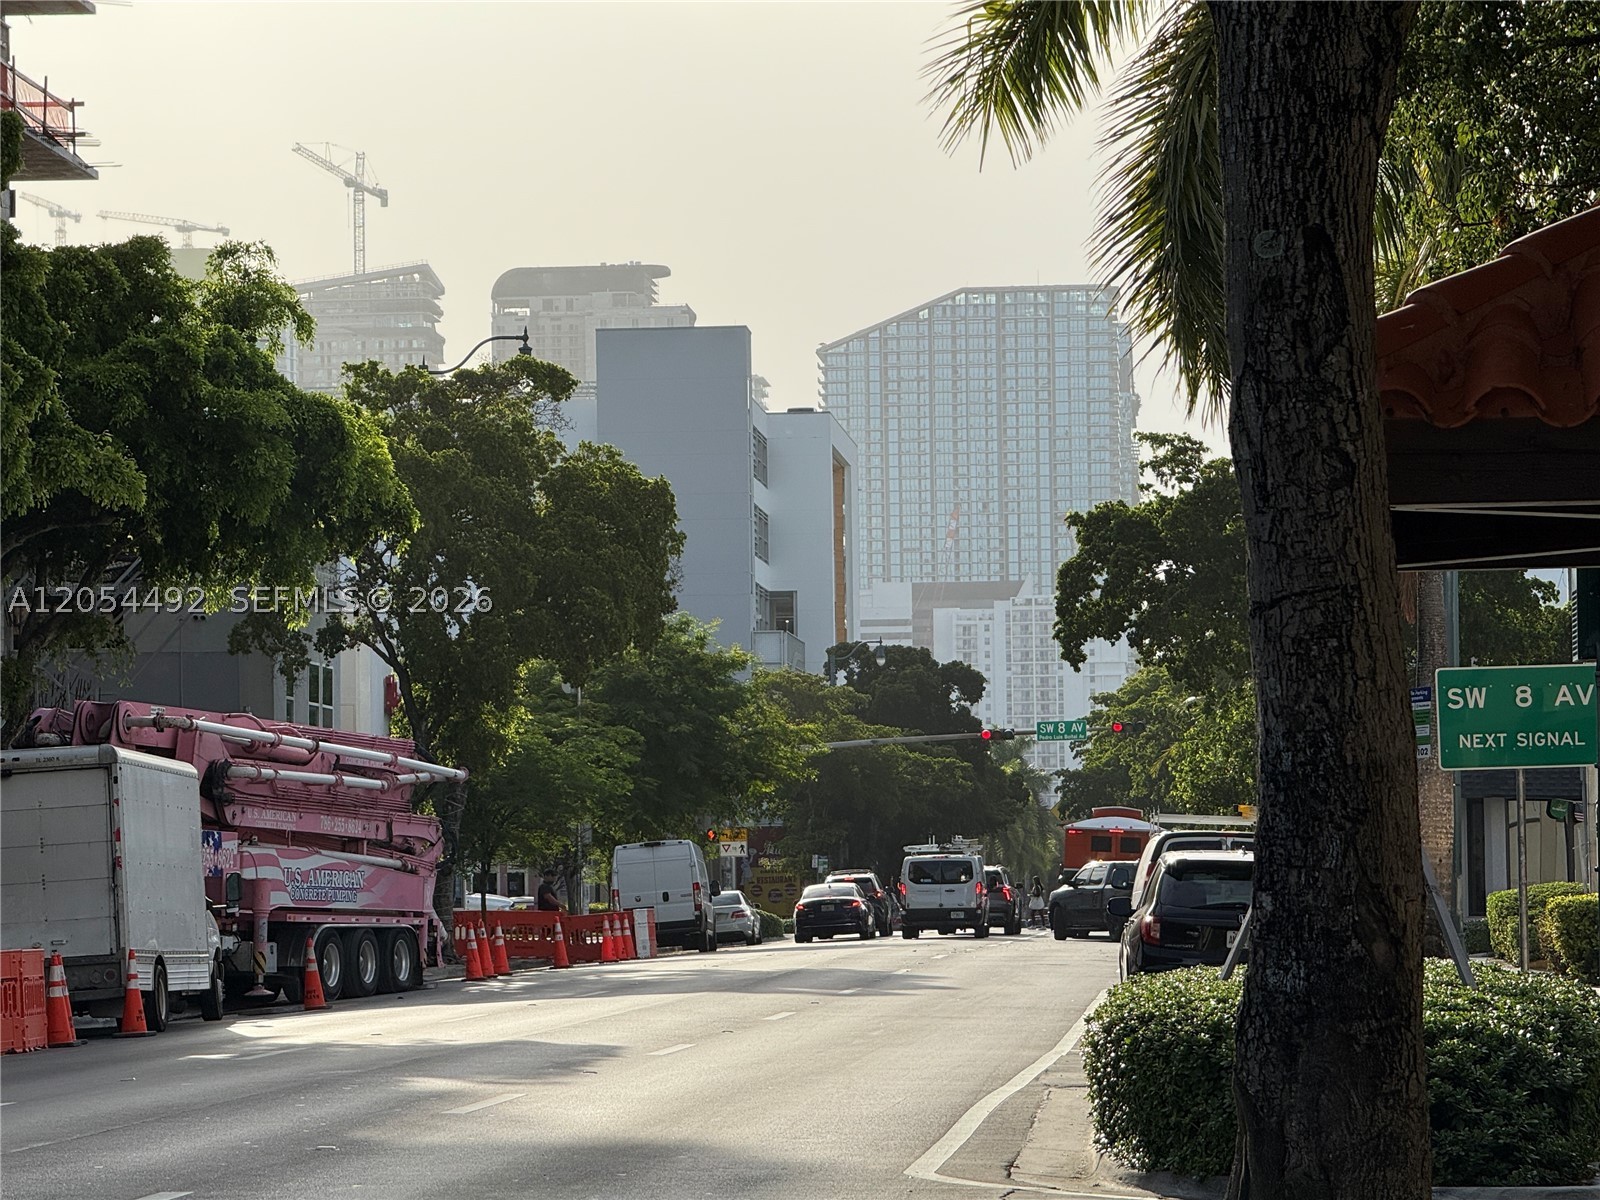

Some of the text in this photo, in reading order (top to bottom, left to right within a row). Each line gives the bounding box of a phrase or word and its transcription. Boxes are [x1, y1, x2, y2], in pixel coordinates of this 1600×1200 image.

[1447, 683, 1595, 709] SW 8 AV
[1040, 722, 1083, 734] SW 8 AV
[1459, 731, 1586, 748] NEXT SIGNAL
[247, 808, 297, 822] U.S. AMERICAN
[283, 868, 365, 889] U.S. AMERICAN
[290, 887, 358, 903] CONCRETE PUMPING
